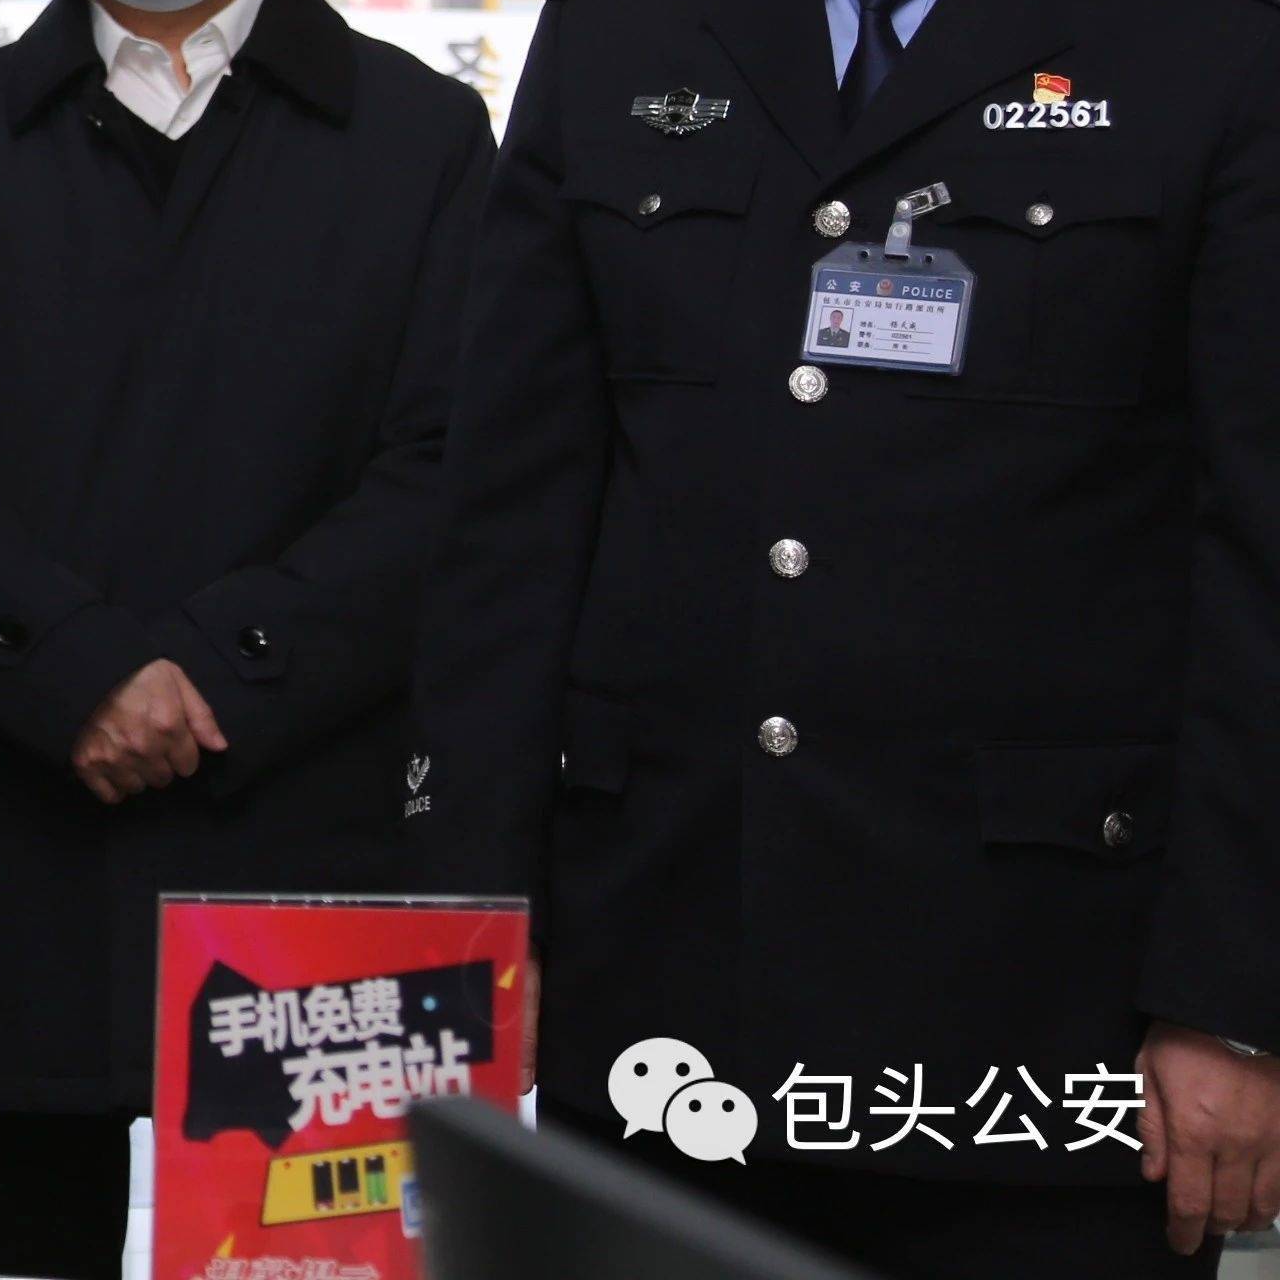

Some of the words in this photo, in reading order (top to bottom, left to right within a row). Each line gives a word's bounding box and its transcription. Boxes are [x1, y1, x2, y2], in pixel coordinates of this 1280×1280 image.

[983, 100, 1111, 130] 022561
[902, 285, 953, 300] POLICE
[208, 977, 404, 1058] 手机免费
[282, 1028, 471, 1132] 充电站
